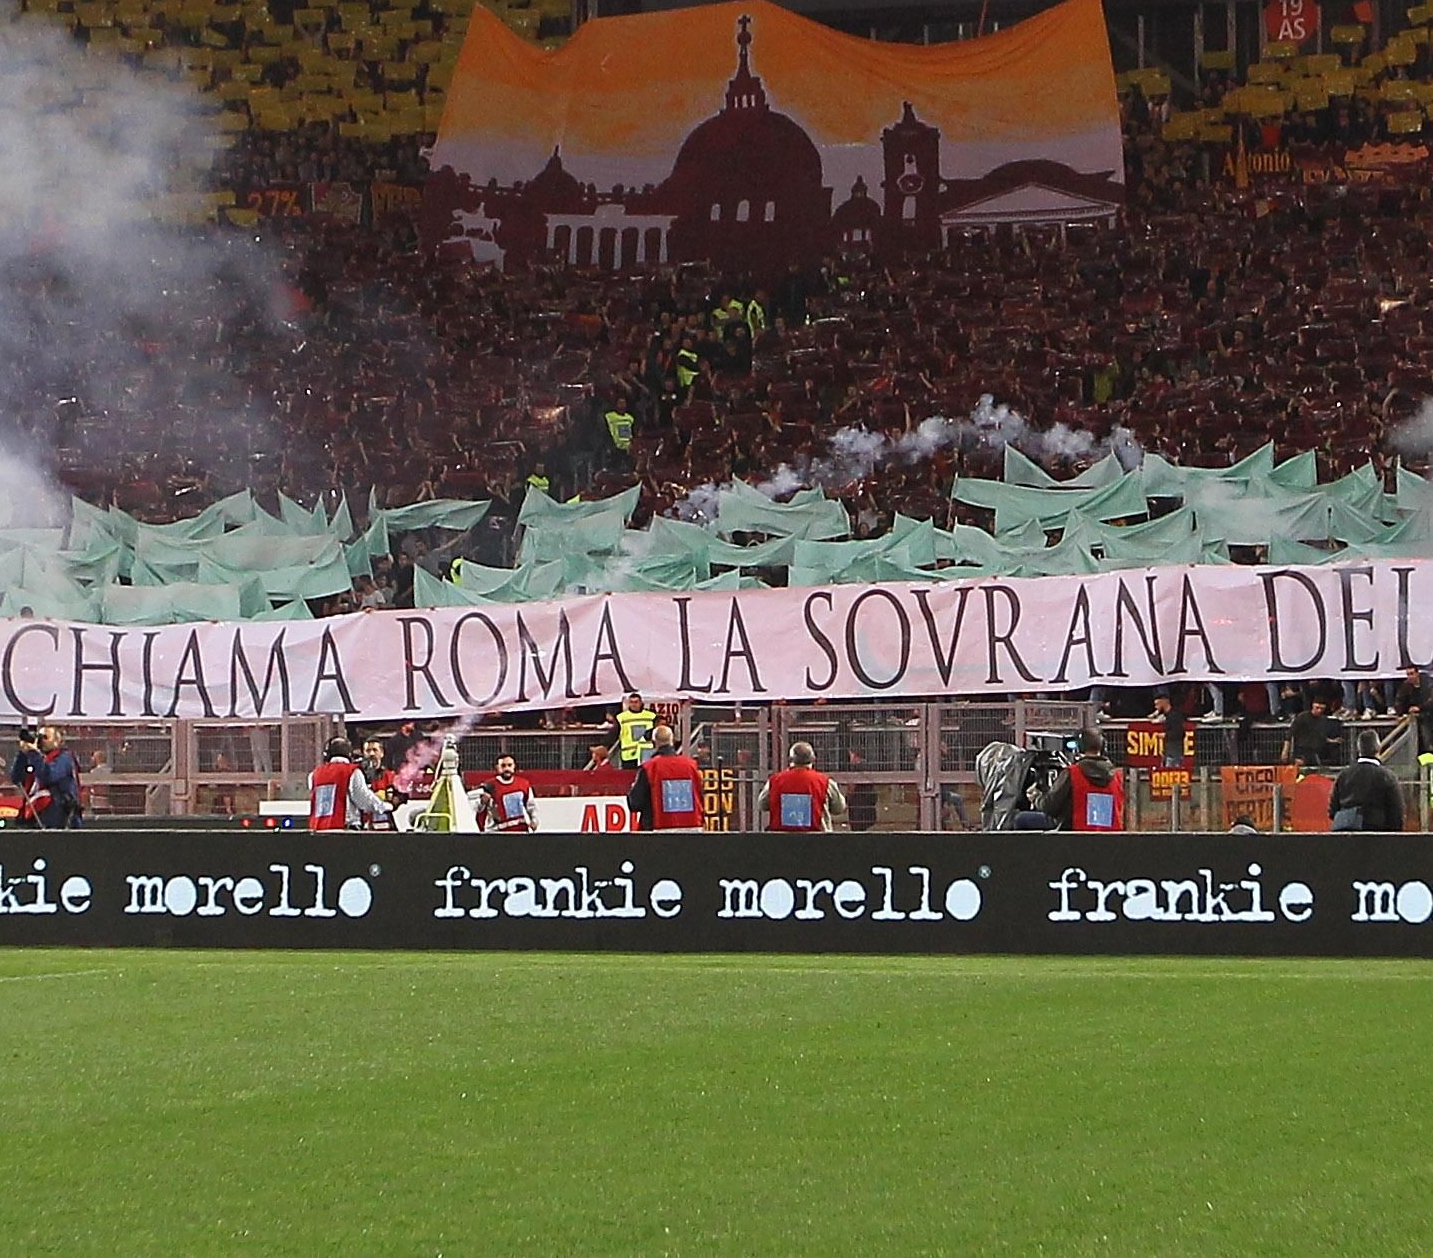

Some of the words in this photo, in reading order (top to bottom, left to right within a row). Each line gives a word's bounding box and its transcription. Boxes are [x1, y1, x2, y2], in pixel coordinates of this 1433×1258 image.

[1277, 17, 1306, 40] AS
[1, 622, 361, 719] CHIAMA
[395, 601, 641, 711] ROMA
[671, 595, 768, 694] LA
[803, 574, 1227, 692] SOVRANA
[124, 864, 372, 918] morello
[434, 860, 682, 919] frankie
[717, 866, 981, 921] morello
[1047, 863, 1314, 922] frankie
